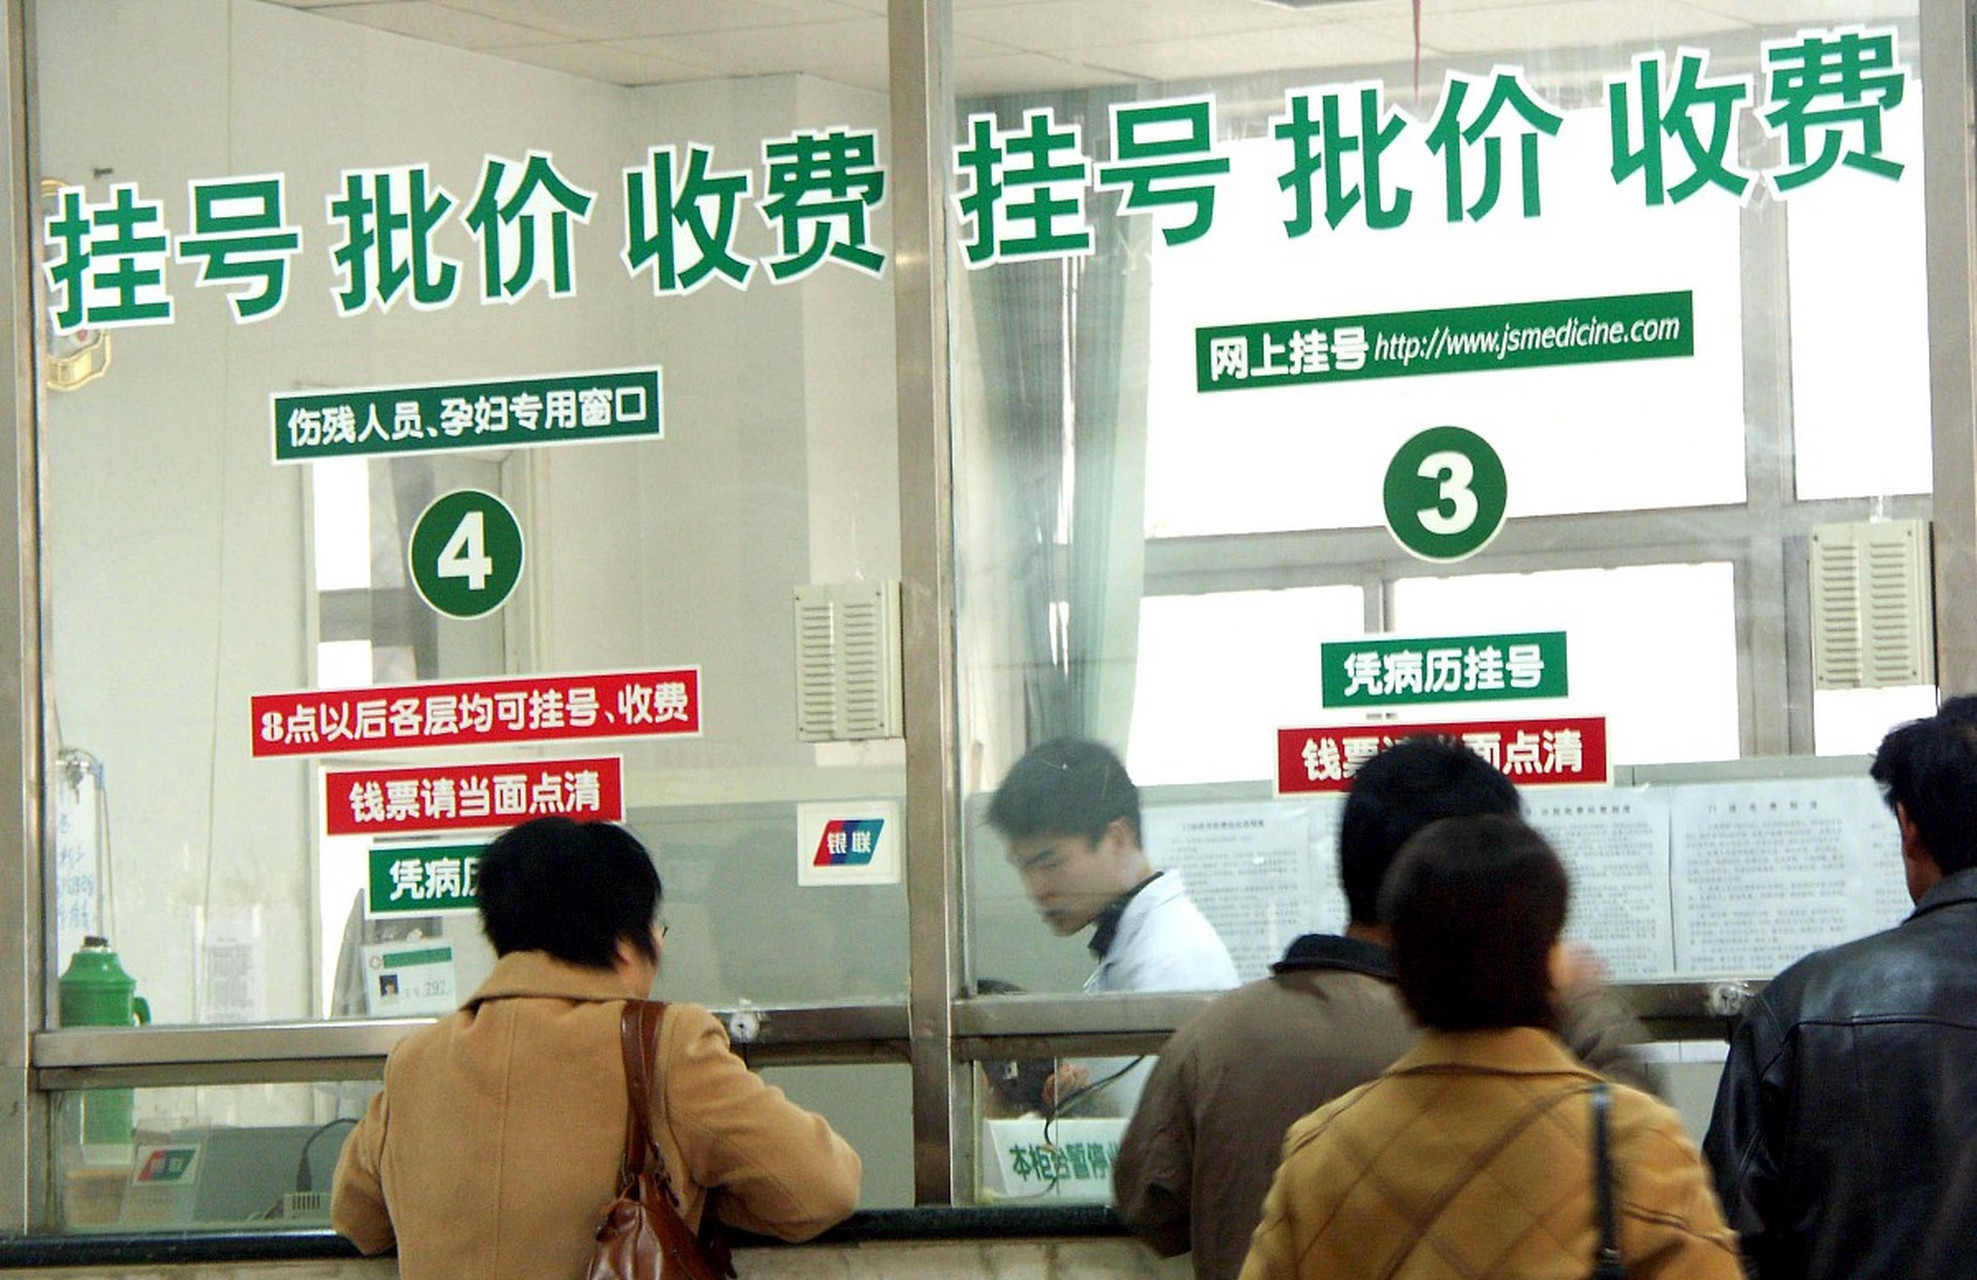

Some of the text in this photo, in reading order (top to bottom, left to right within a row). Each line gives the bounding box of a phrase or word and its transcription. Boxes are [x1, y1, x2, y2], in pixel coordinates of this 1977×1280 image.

[956, 32, 1906, 265] 挂号 批价 收费
[50, 131, 886, 330] 挂号 批价 收费
[1210, 315, 1680, 382] 网上挂号 http://www.jsmedicine.com
[287, 386, 647, 448] 伤残人员、孕妇专用窗口
[1417, 451, 1479, 535] 3
[437, 511, 492, 590] 4
[1343, 644, 1545, 697] 凭病历挂号
[261, 681, 689, 744] 8点以后各层均可挂号、收费
[1301, 728, 1583, 782] 钱票面点清
[348, 770, 600, 823] 钱票请当面点清
